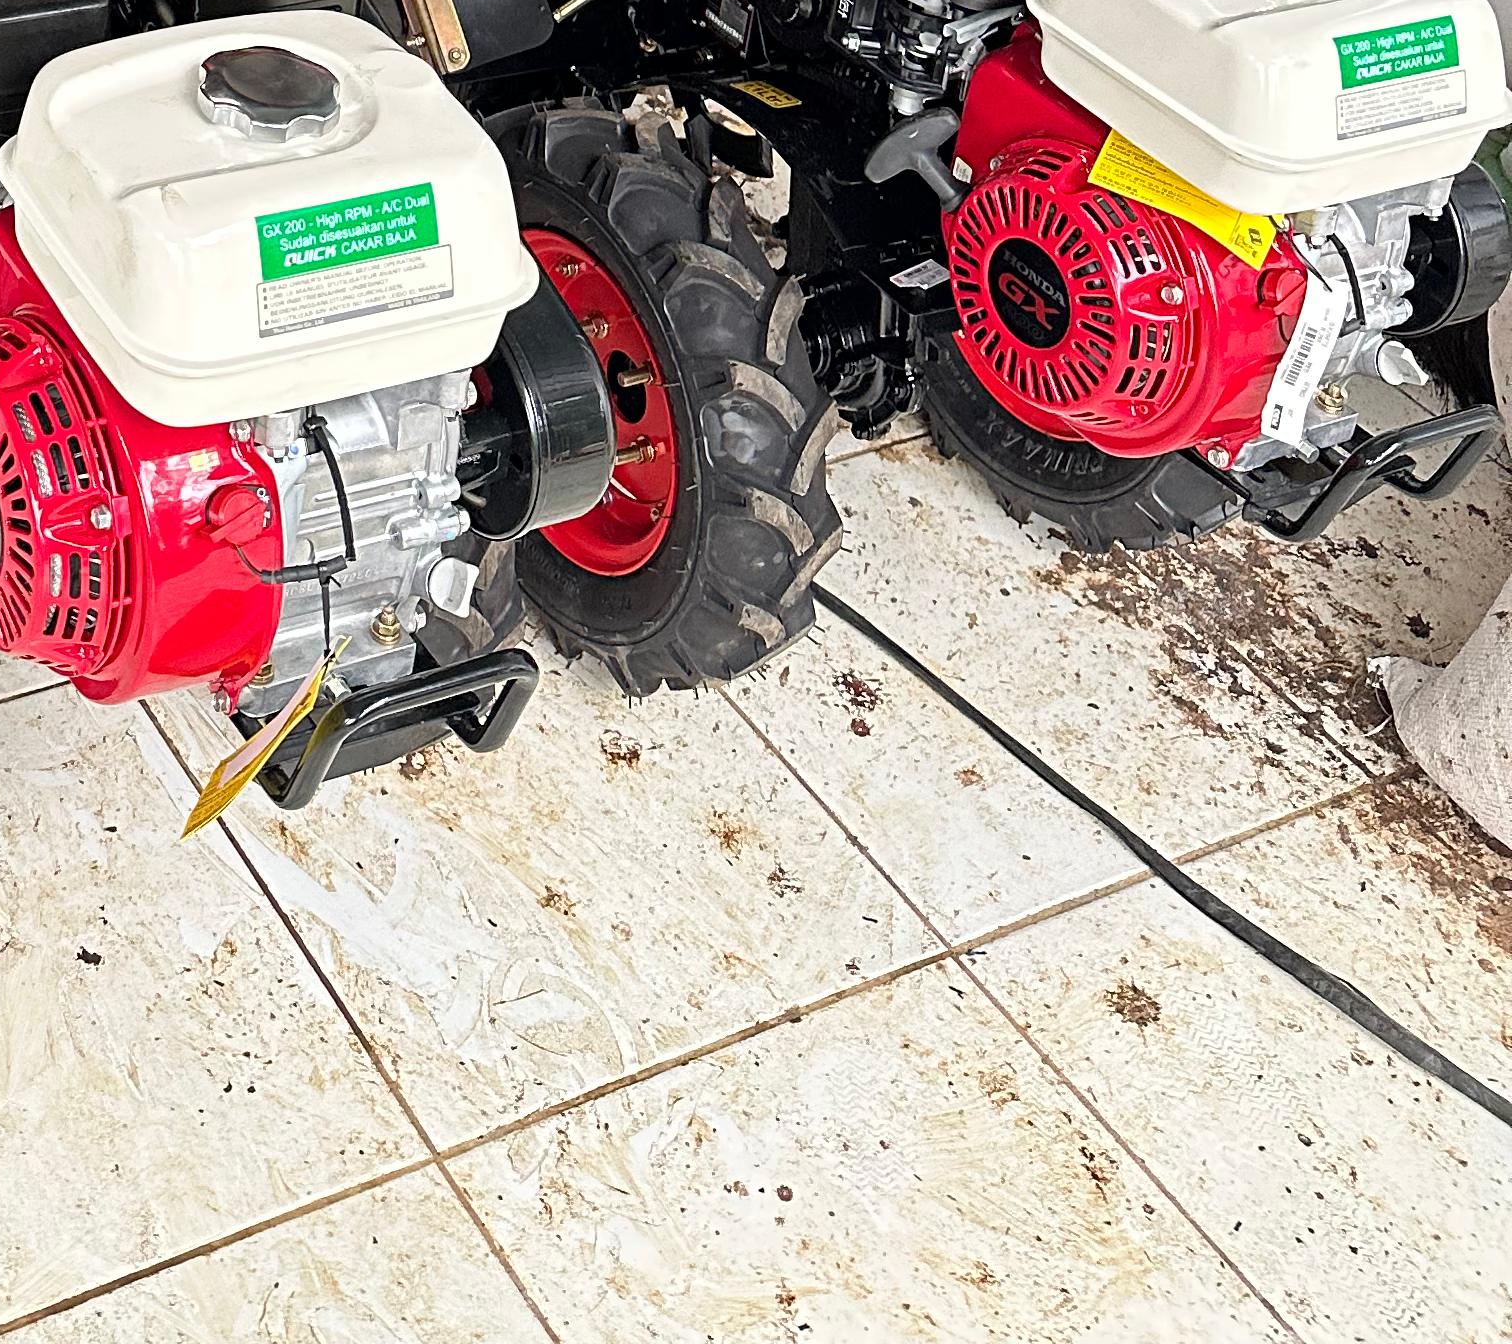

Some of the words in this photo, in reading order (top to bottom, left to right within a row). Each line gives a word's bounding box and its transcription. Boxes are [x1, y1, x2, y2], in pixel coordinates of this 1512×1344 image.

[1340, 43, 1354, 56] GX
[1354, 40, 1371, 53] 200
[1395, 31, 1415, 44] RPM
[1394, 57, 1423, 72] CAKAR
[1423, 52, 1445, 66] BAJA
[262, 223, 282, 239] GX
[285, 218, 306, 235] 200
[316, 210, 343, 229] High
[344, 205, 373, 222] RPM
[381, 198, 402, 215] A/C
[404, 193, 431, 210] Dual
[280, 234, 317, 252] Sudah
[319, 220, 385, 244] disesuaikan
[387, 213, 417, 230] untuk
[283, 244, 337, 268] QUICK
[341, 235, 383, 255] CAKAR
[386, 228, 417, 246] BAJA
[1002, 249, 1066, 308] HONDA
[998, 272, 1061, 331] GX
